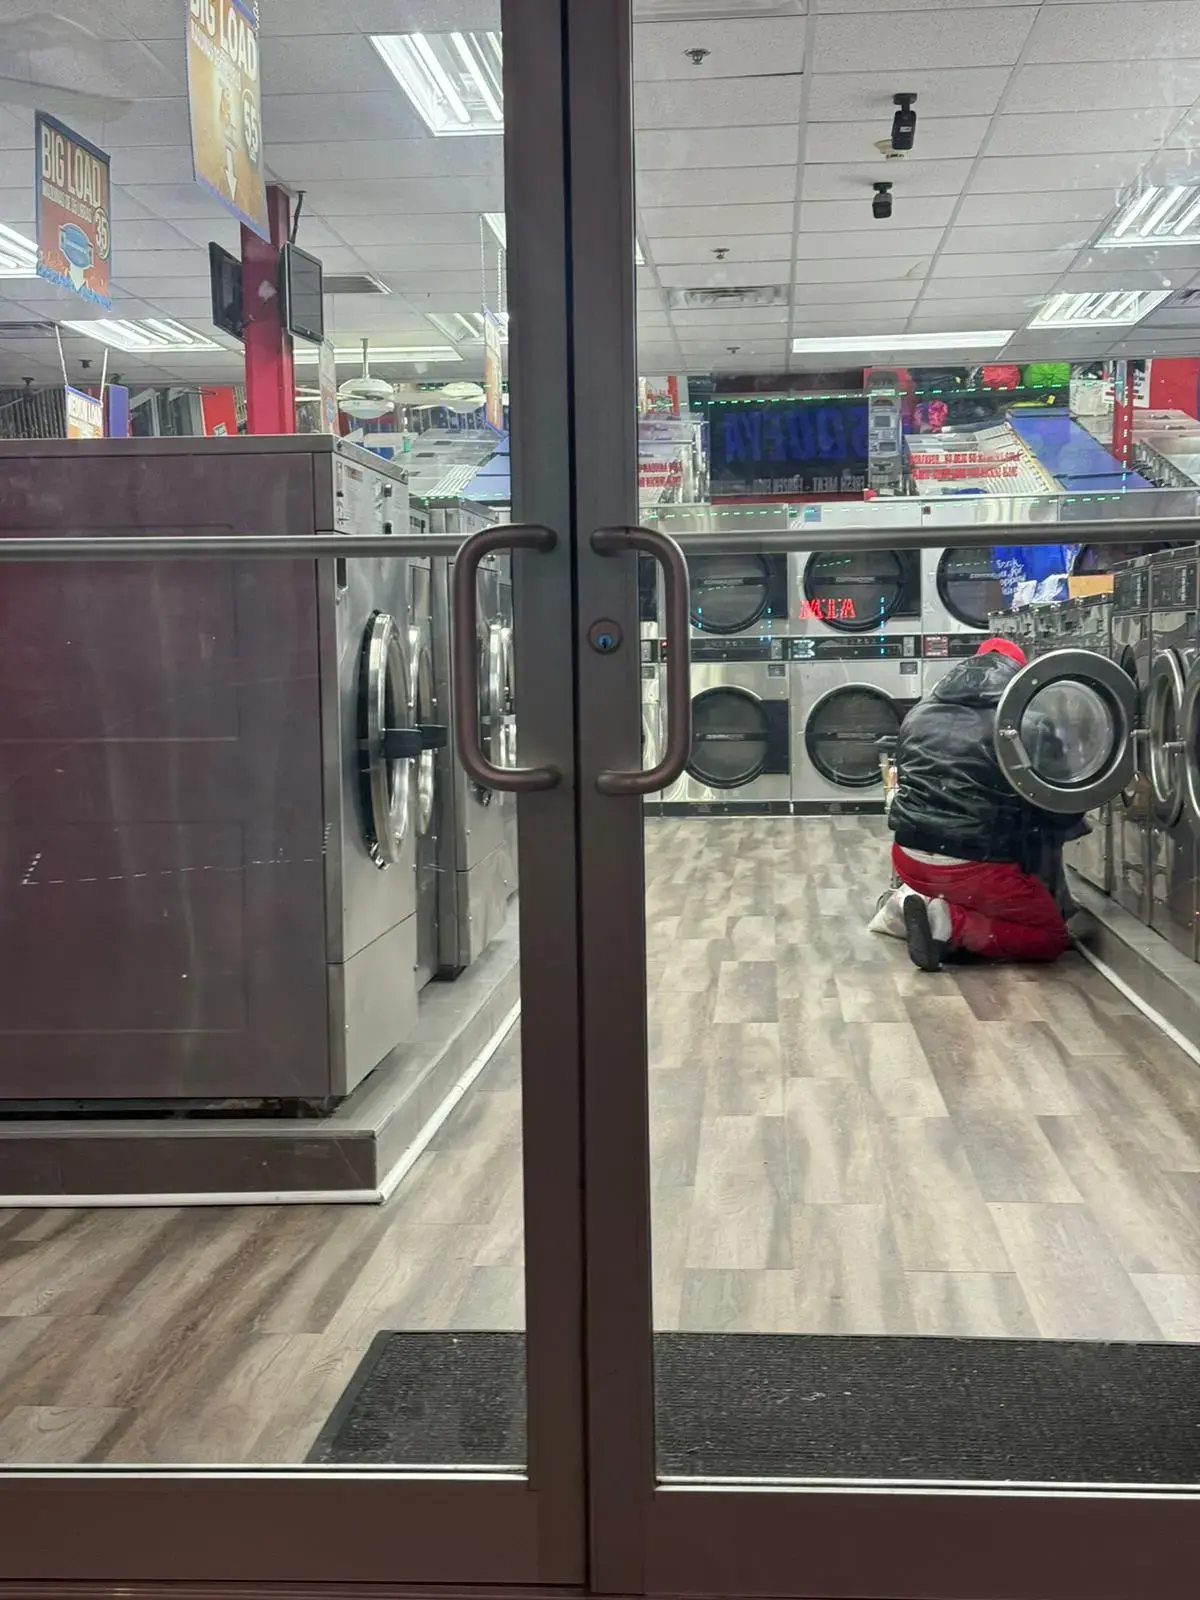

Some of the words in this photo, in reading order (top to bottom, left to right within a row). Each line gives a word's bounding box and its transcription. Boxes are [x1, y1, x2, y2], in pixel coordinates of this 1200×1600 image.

[220, 0, 257, 81] LOAD
[41, 124, 64, 188] BIG
[67, 141, 101, 208] LOAD
